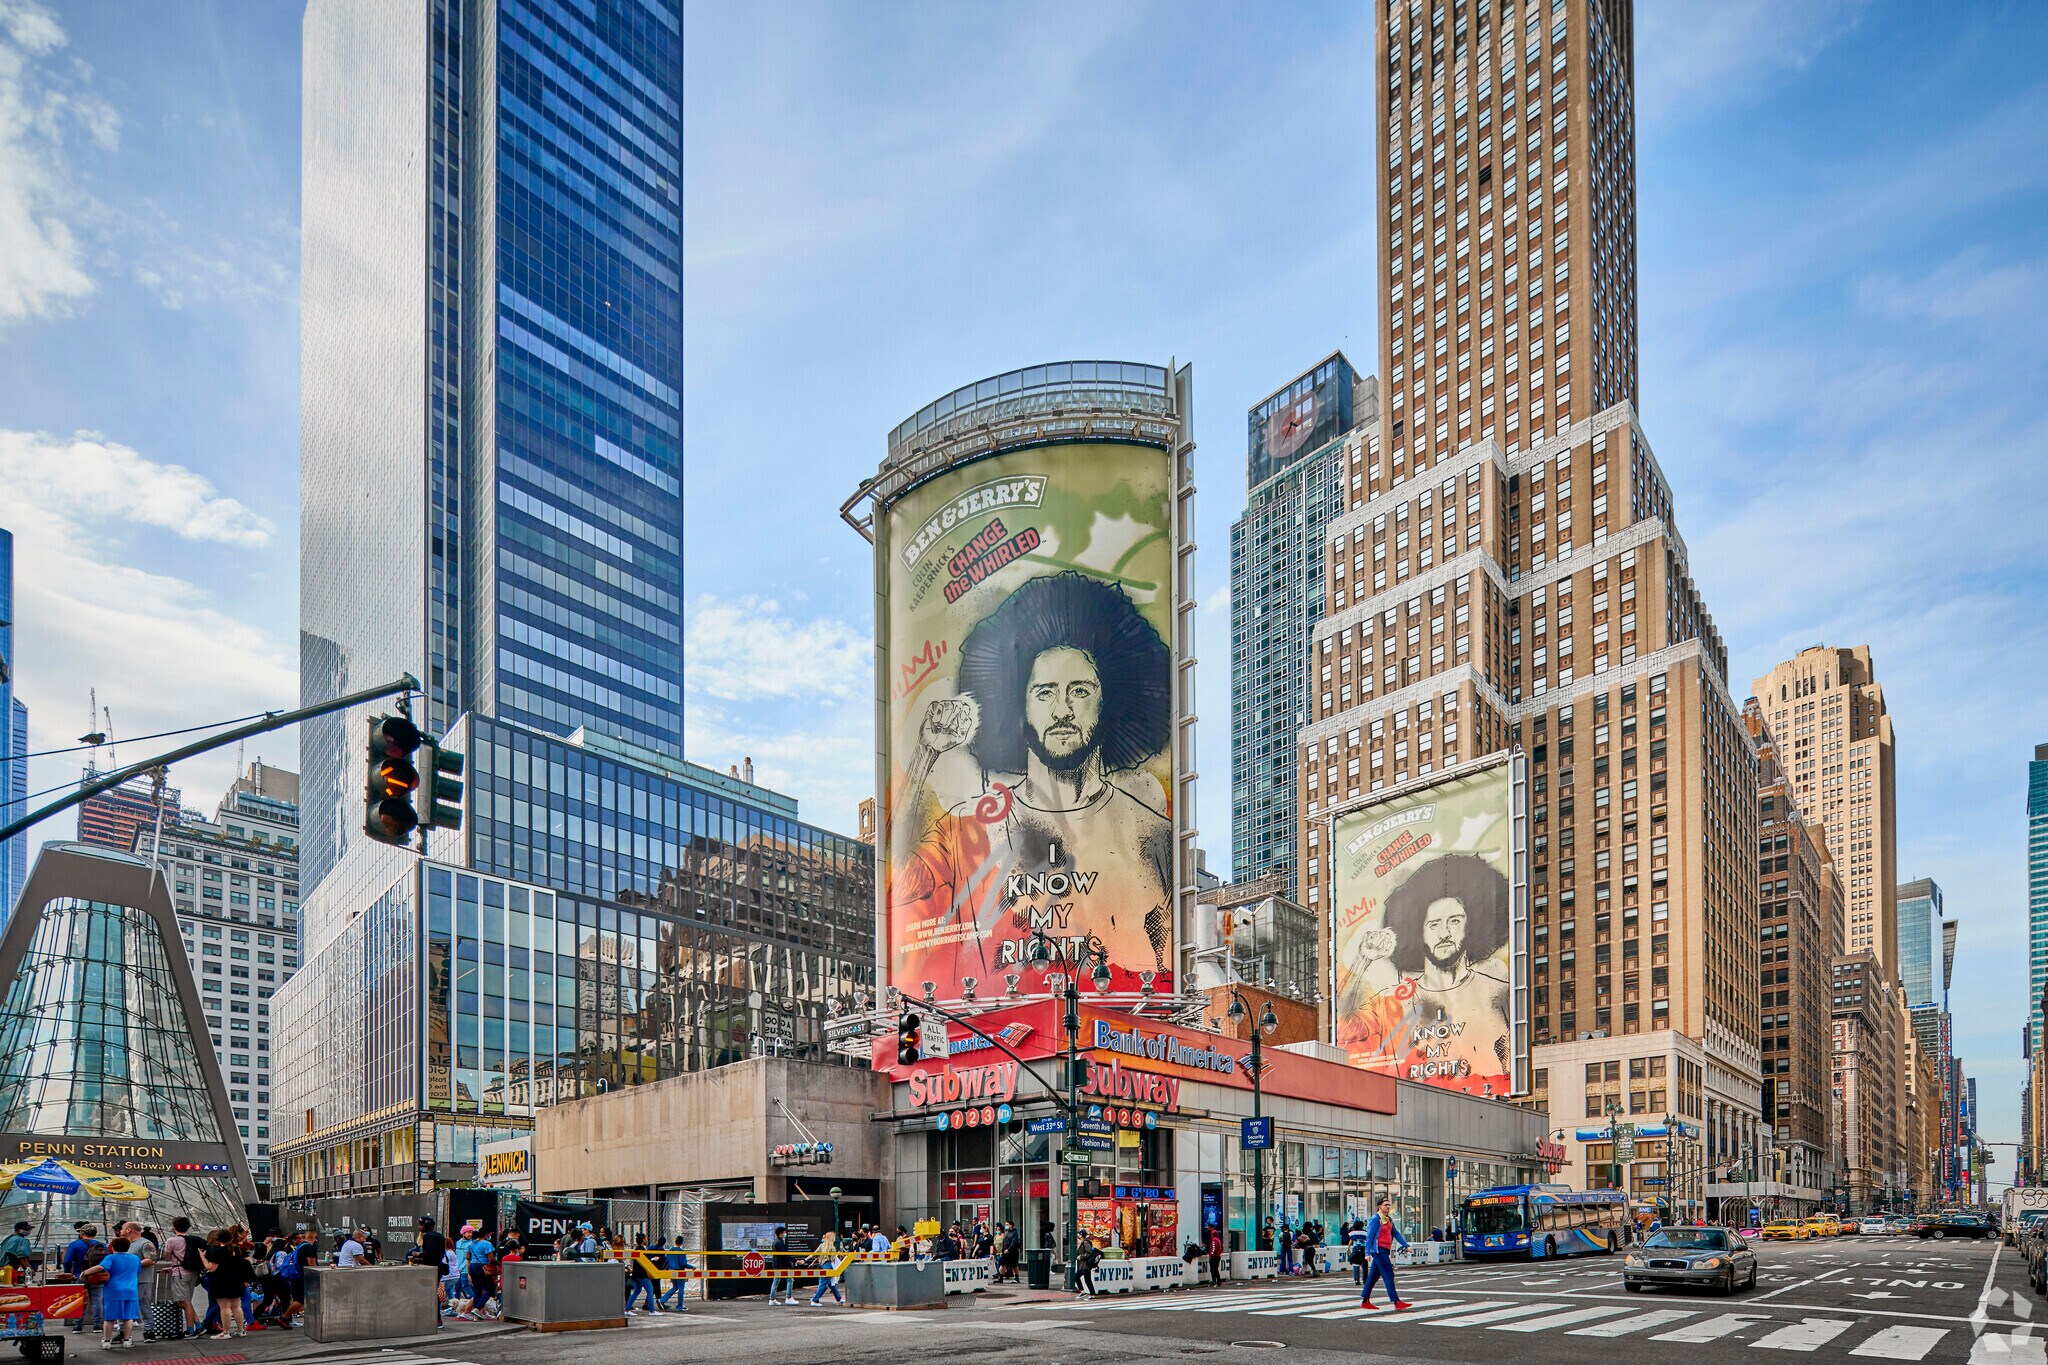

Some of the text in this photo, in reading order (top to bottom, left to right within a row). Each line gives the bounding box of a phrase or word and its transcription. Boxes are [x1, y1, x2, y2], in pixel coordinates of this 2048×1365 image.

[905, 479, 1041, 565] BEN & JERRY'S
[949, 518, 1008, 578] CHANGE
[912, 559, 934, 587] COLIN
[944, 577, 972, 603] the
[967, 528, 1040, 585] WHIRLED
[908, 545, 955, 612] KAEPERNICK'S
[1347, 829, 1372, 854] BEN
[1373, 823, 1383, 836] &
[1377, 830, 1413, 863] CHANGE
[1049, 843, 1057, 864] I
[1353, 852, 1368, 867] COLIN
[1375, 833, 1432, 878] the WHIRLED
[1007, 871, 1099, 899] KNOW
[905, 915, 946, 932] LEARN MORE AT:
[1029, 902, 1074, 930] MY
[1437, 1009, 1442, 1021] I
[927, 1024, 941, 1035] ALL
[1413, 1022, 1467, 1042] KNOW
[924, 1033, 945, 1044] TRAFFIC
[949, 1033, 996, 1055] merica
[1095, 1019, 1234, 1074] Bank of America
[1426, 1041, 1452, 1058] MY
[1410, 1059, 1469, 1079] RIGHTS
[909, 1062, 1019, 1107] Subway
[1077, 1052, 1181, 1113] Subway
[1031, 1121, 1064, 1132] West 33rd St
[1080, 1121, 1111, 1131] Seventh Ave
[19, 1141, 163, 1158] PENN STATION
[1081, 1139, 1111, 1149] Fashion Ave
[1536, 1135, 1567, 1163] Subway
[80, 1160, 112, 1169] Road
[125, 1161, 172, 1172] Subway
[486, 1149, 528, 1175] LENWICH
[1482, 1197, 1499, 1205] SOUTH
[388, 1215, 413, 1227] PENN STATION
[744, 1259, 764, 1269] STOP
[1202, 1259, 1227, 1273] ND
[1252, 1256, 1275, 1269] NYPD
[951, 1266, 984, 1281] NYPD
[1099, 1267, 1130, 1281] NYPD
[1150, 1264, 1180, 1279] NYPD
[1819, 1277, 1965, 1290] ONLY
